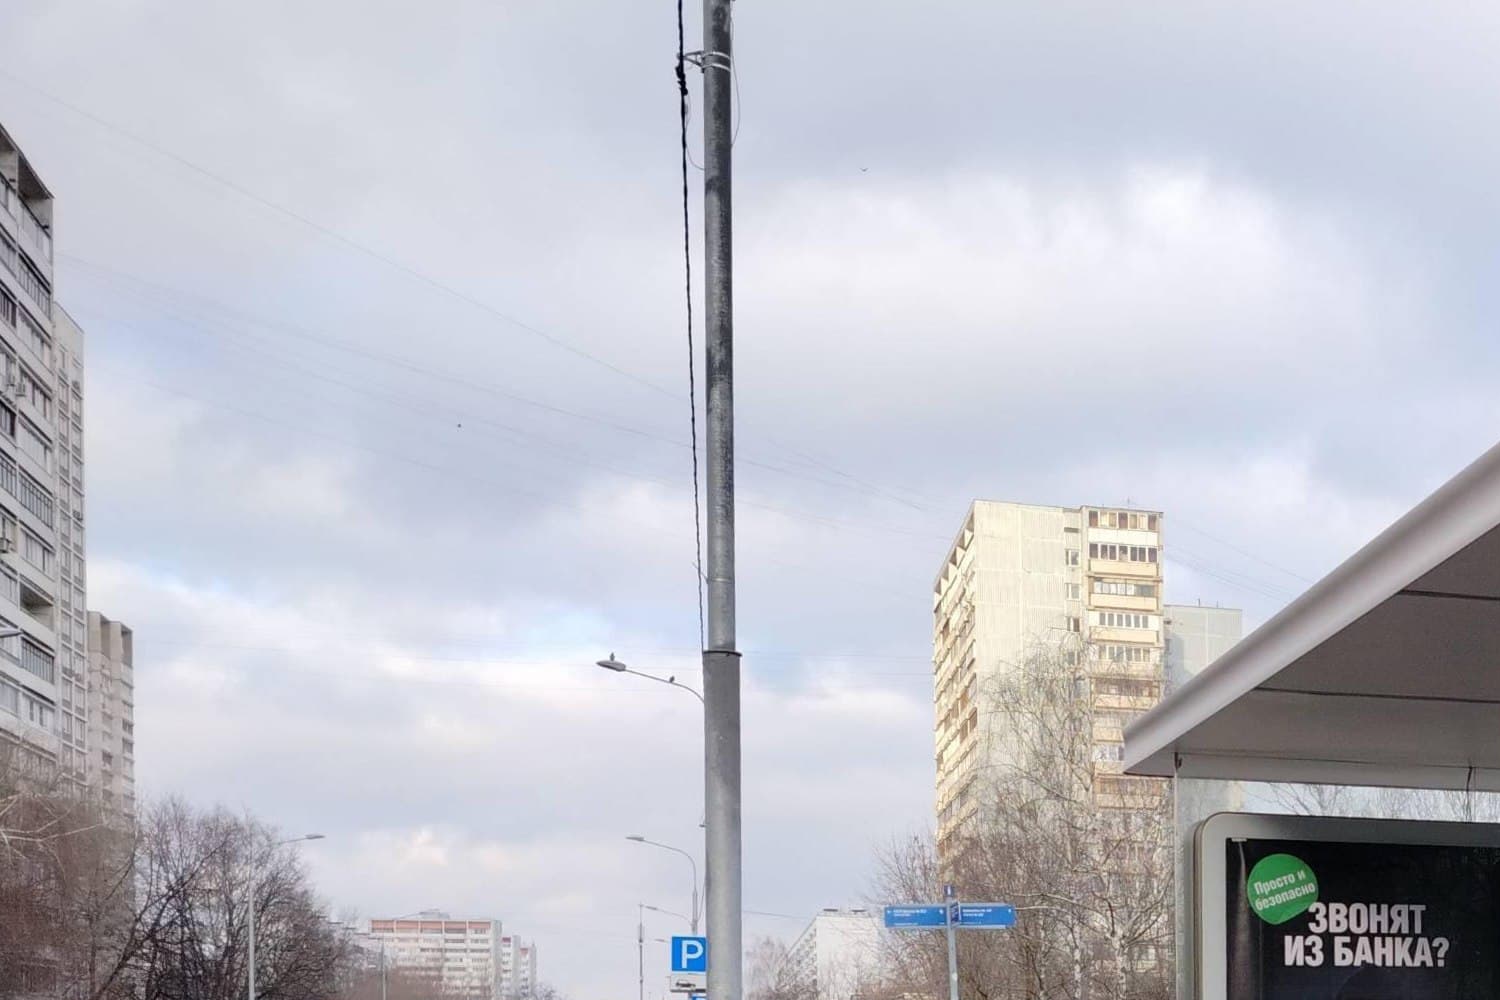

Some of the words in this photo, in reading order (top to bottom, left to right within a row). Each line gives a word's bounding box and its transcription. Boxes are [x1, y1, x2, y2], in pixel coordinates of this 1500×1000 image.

[1253, 873, 1295, 895] Просто
[1297, 869, 1306, 883] и
[1254, 881, 1316, 911] безопасно
[1307, 902, 1427, 934] ЗВОНЯТ
[1284, 935, 1324, 967] ИЗ
[1333, 936, 1450, 967] БАНКА?
